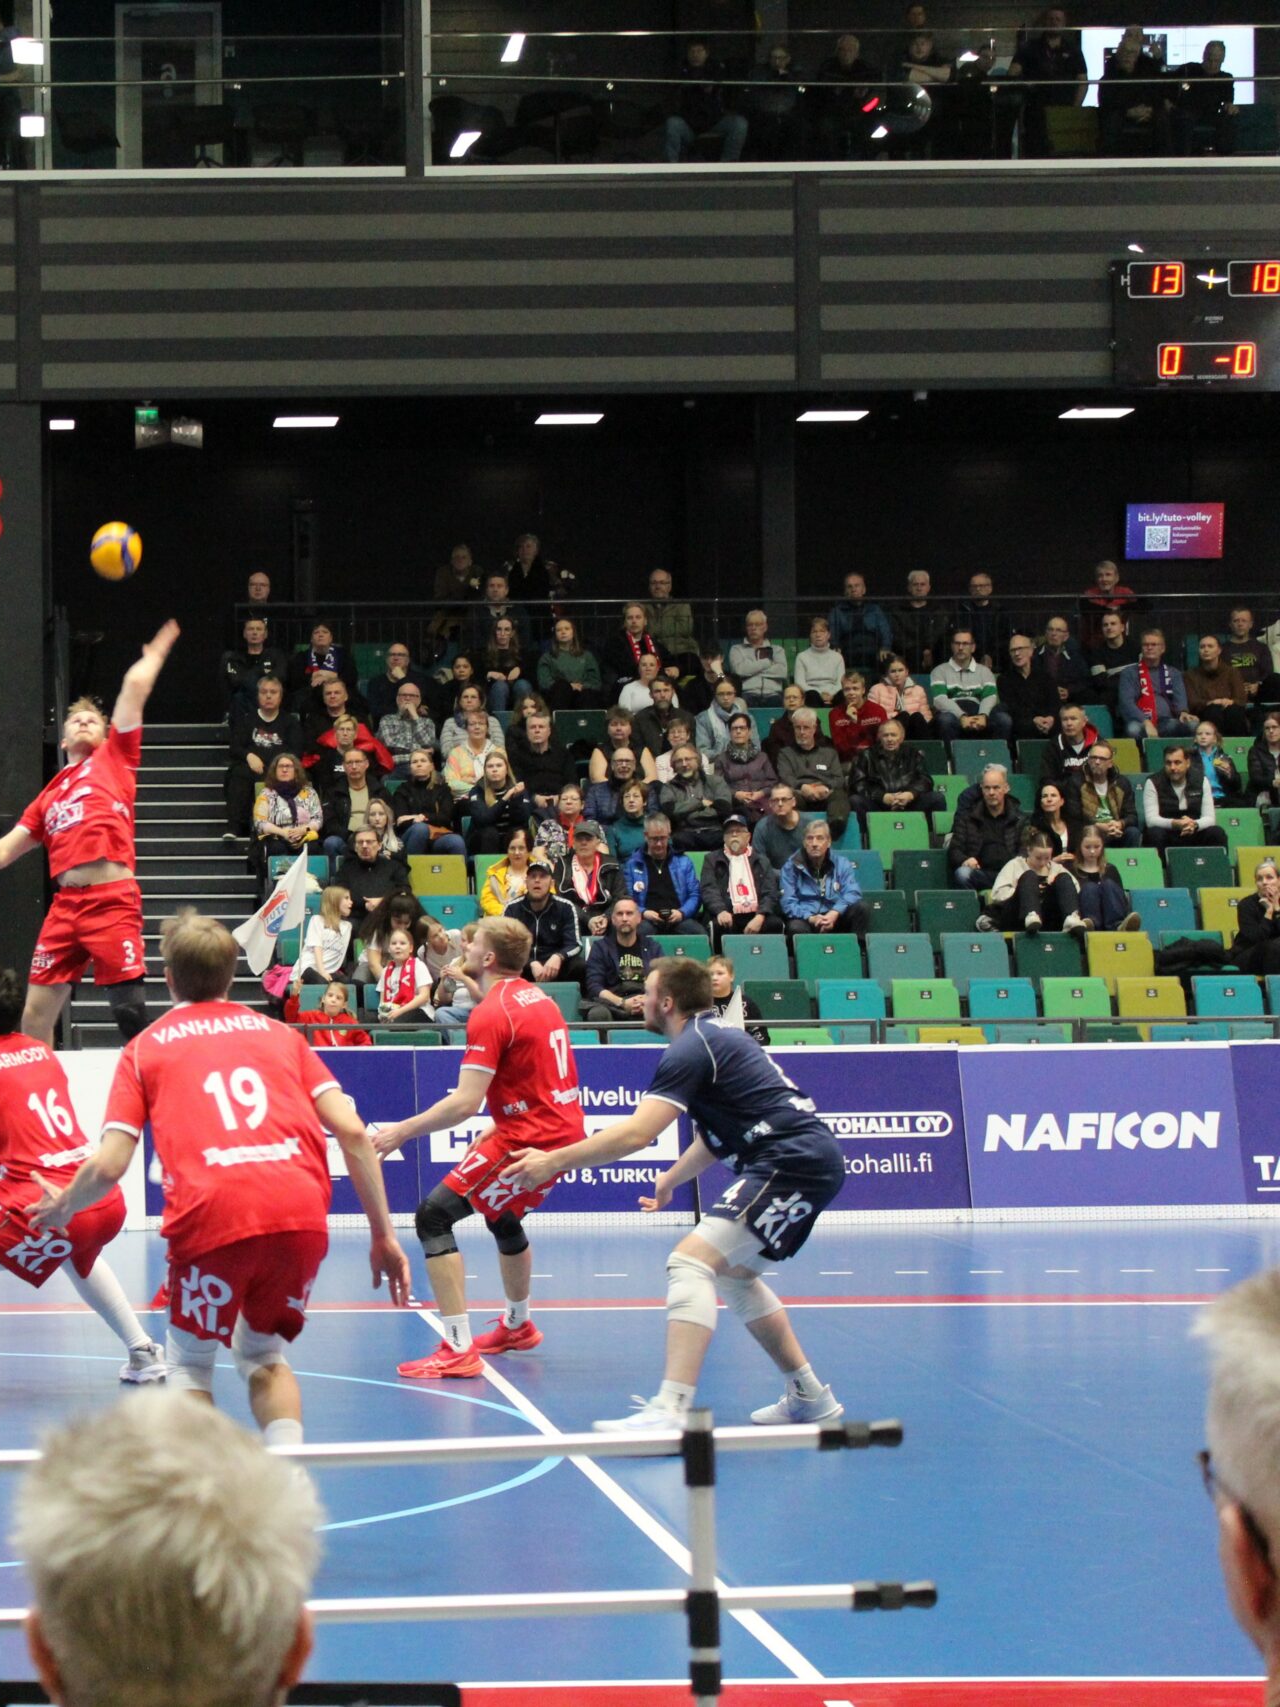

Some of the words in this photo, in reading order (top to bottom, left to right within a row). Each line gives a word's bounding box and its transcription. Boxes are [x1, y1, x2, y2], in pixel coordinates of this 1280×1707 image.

[1152, 264, 1182, 294] 13
[1252, 263, 1280, 293] 18
[1161, 346, 1181, 375] 0
[1137, 511, 1212, 525] bit.ly/tuto-volley
[122, 940, 136, 964] 3
[152, 1014, 271, 1045] VANHANEN
[549, 1028, 569, 1080] 17
[28, 1088, 74, 1138] 16
[203, 1066, 268, 1131] 19
[826, 1117, 911, 1133] TOHALLI
[915, 1116, 943, 1132] OY
[983, 1111, 1221, 1152] NAFICON
[599, 1168, 660, 1184] TURKU
[843, 1152, 933, 1174] tohalli.fi
[722, 1179, 747, 1204] 4
[772, 1190, 813, 1223] JO
[24, 1229, 73, 1258] JO
[180, 1265, 233, 1306] JO
[180, 1287, 230, 1336] KI.
